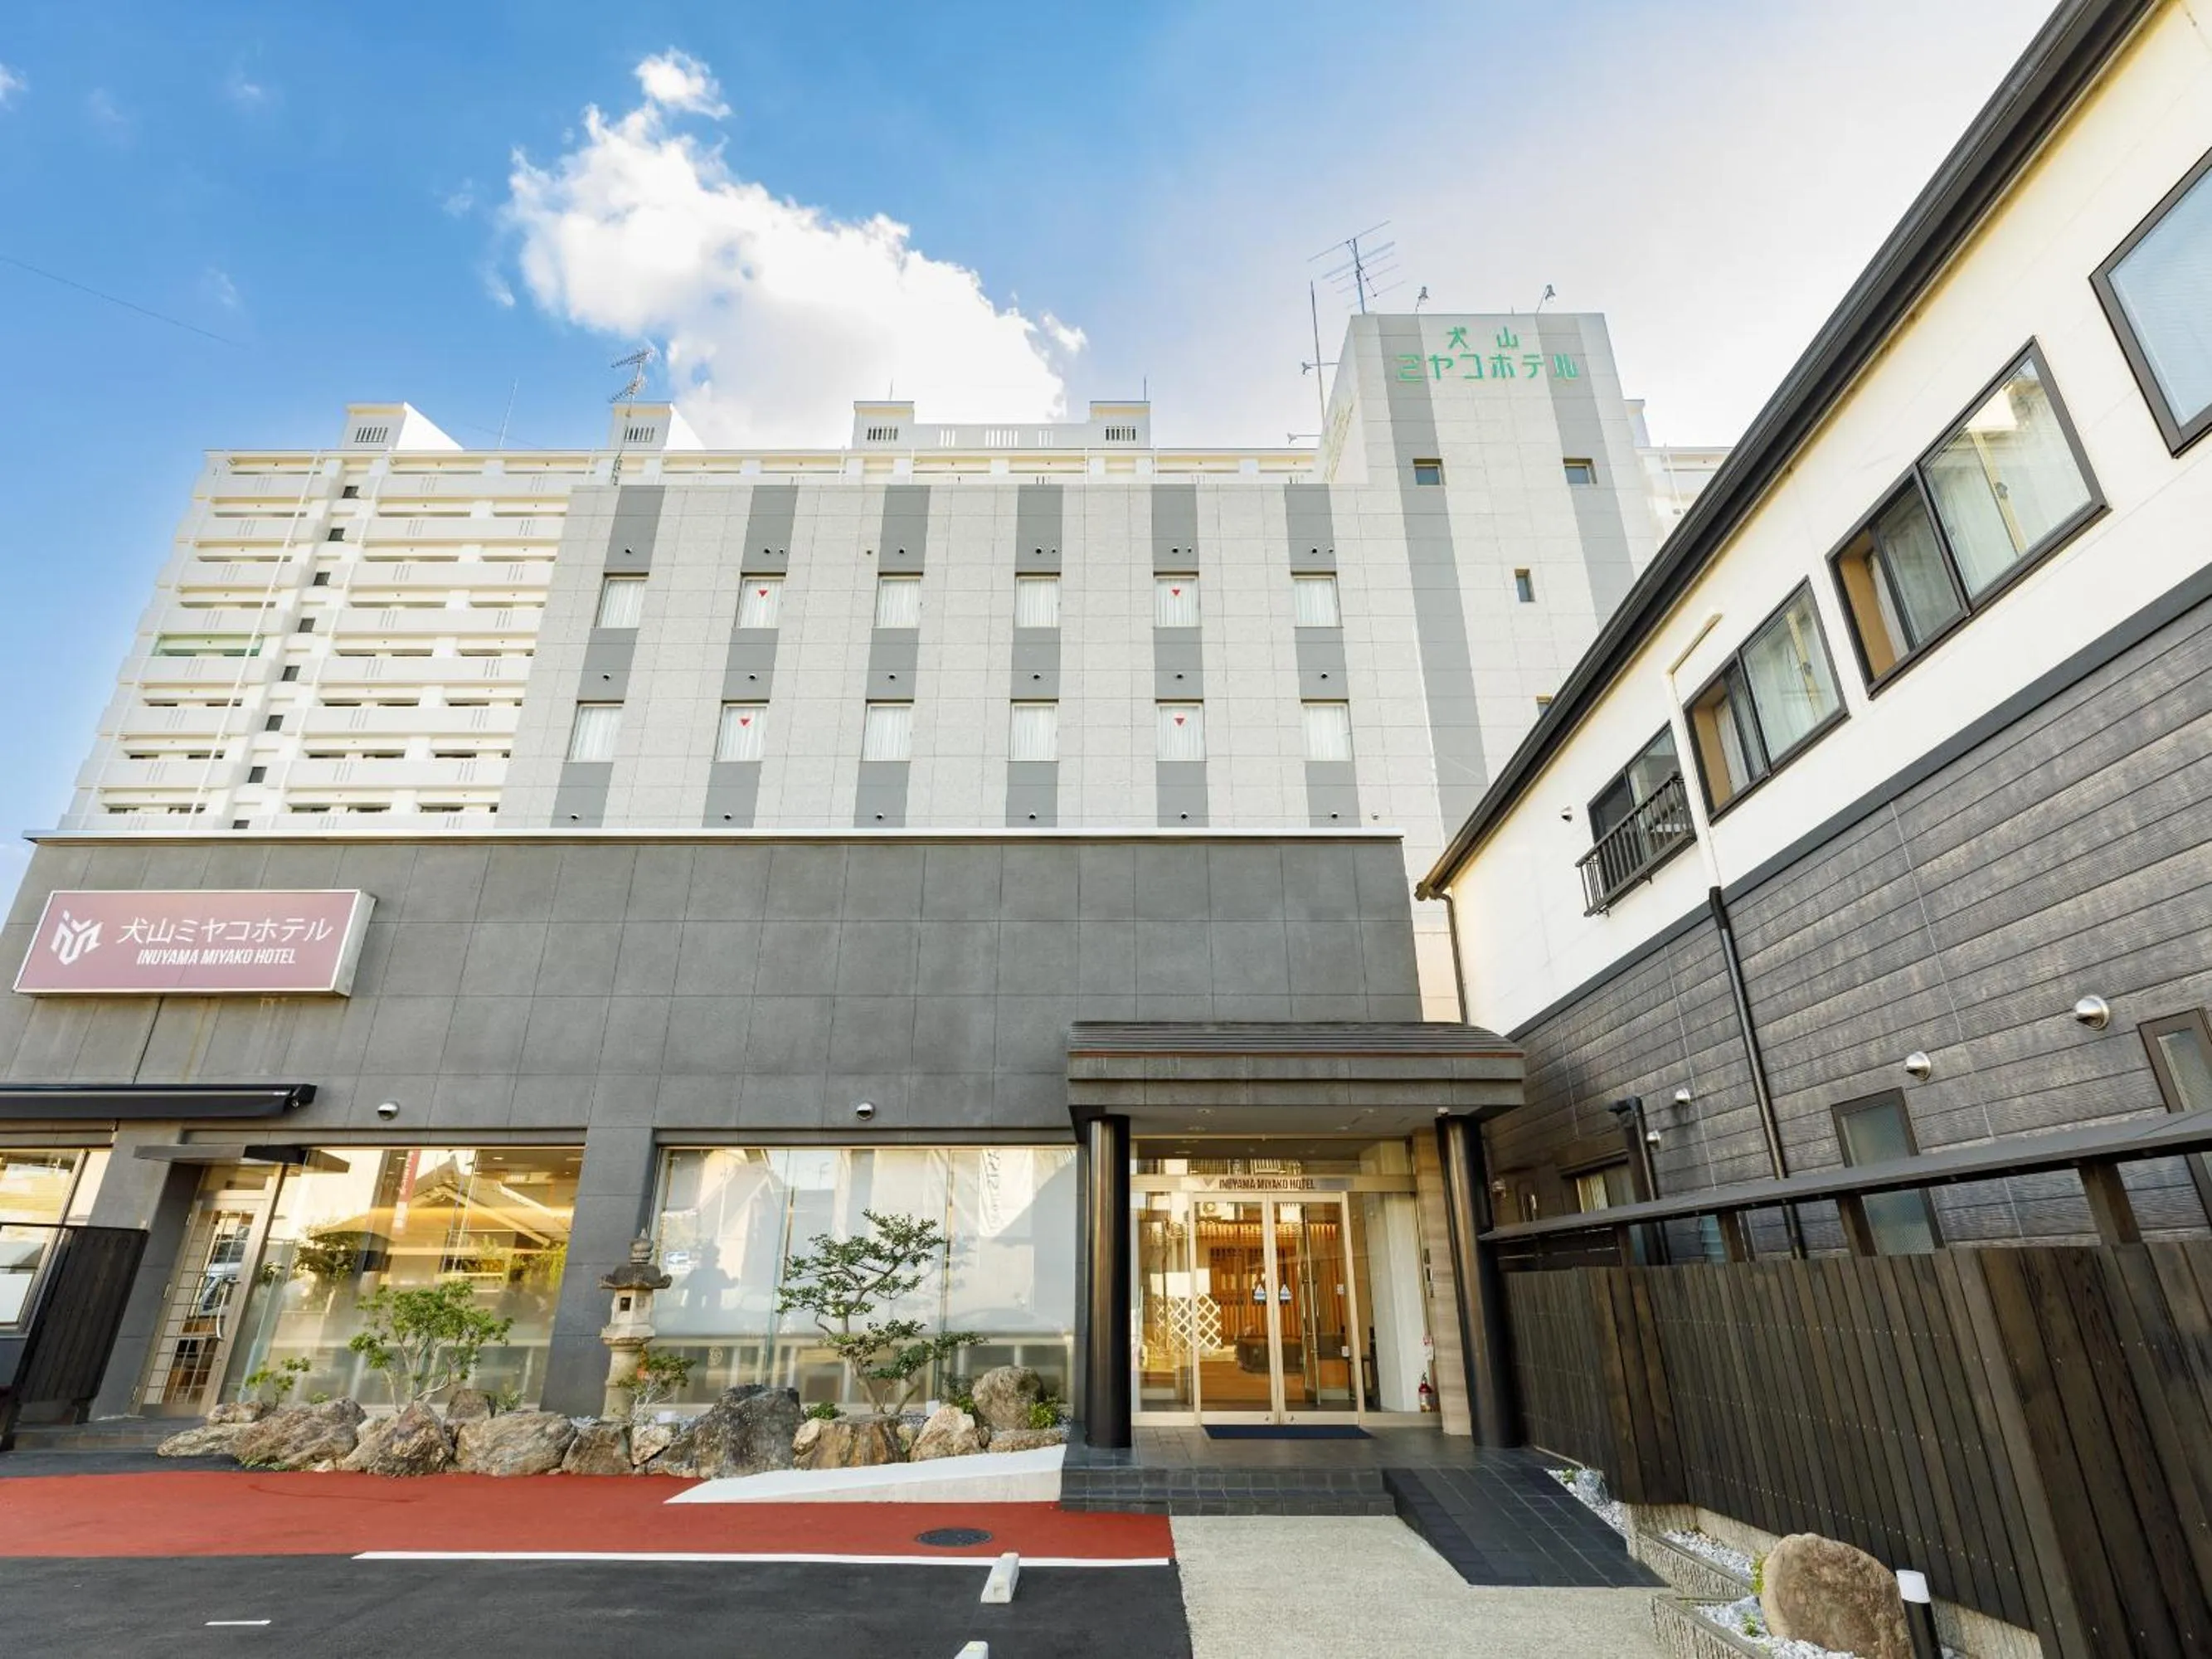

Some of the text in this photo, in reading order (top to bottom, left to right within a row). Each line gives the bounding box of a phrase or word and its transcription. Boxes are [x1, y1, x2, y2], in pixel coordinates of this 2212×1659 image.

[1395, 353, 1579, 380] ミヤコホテル
[116, 917, 333, 944] 犬山ミヤコホテル
[137, 948, 296, 965] INUYAMA MIYAKO HOTEL
[1291, 1178, 1315, 1190] HOTEL
